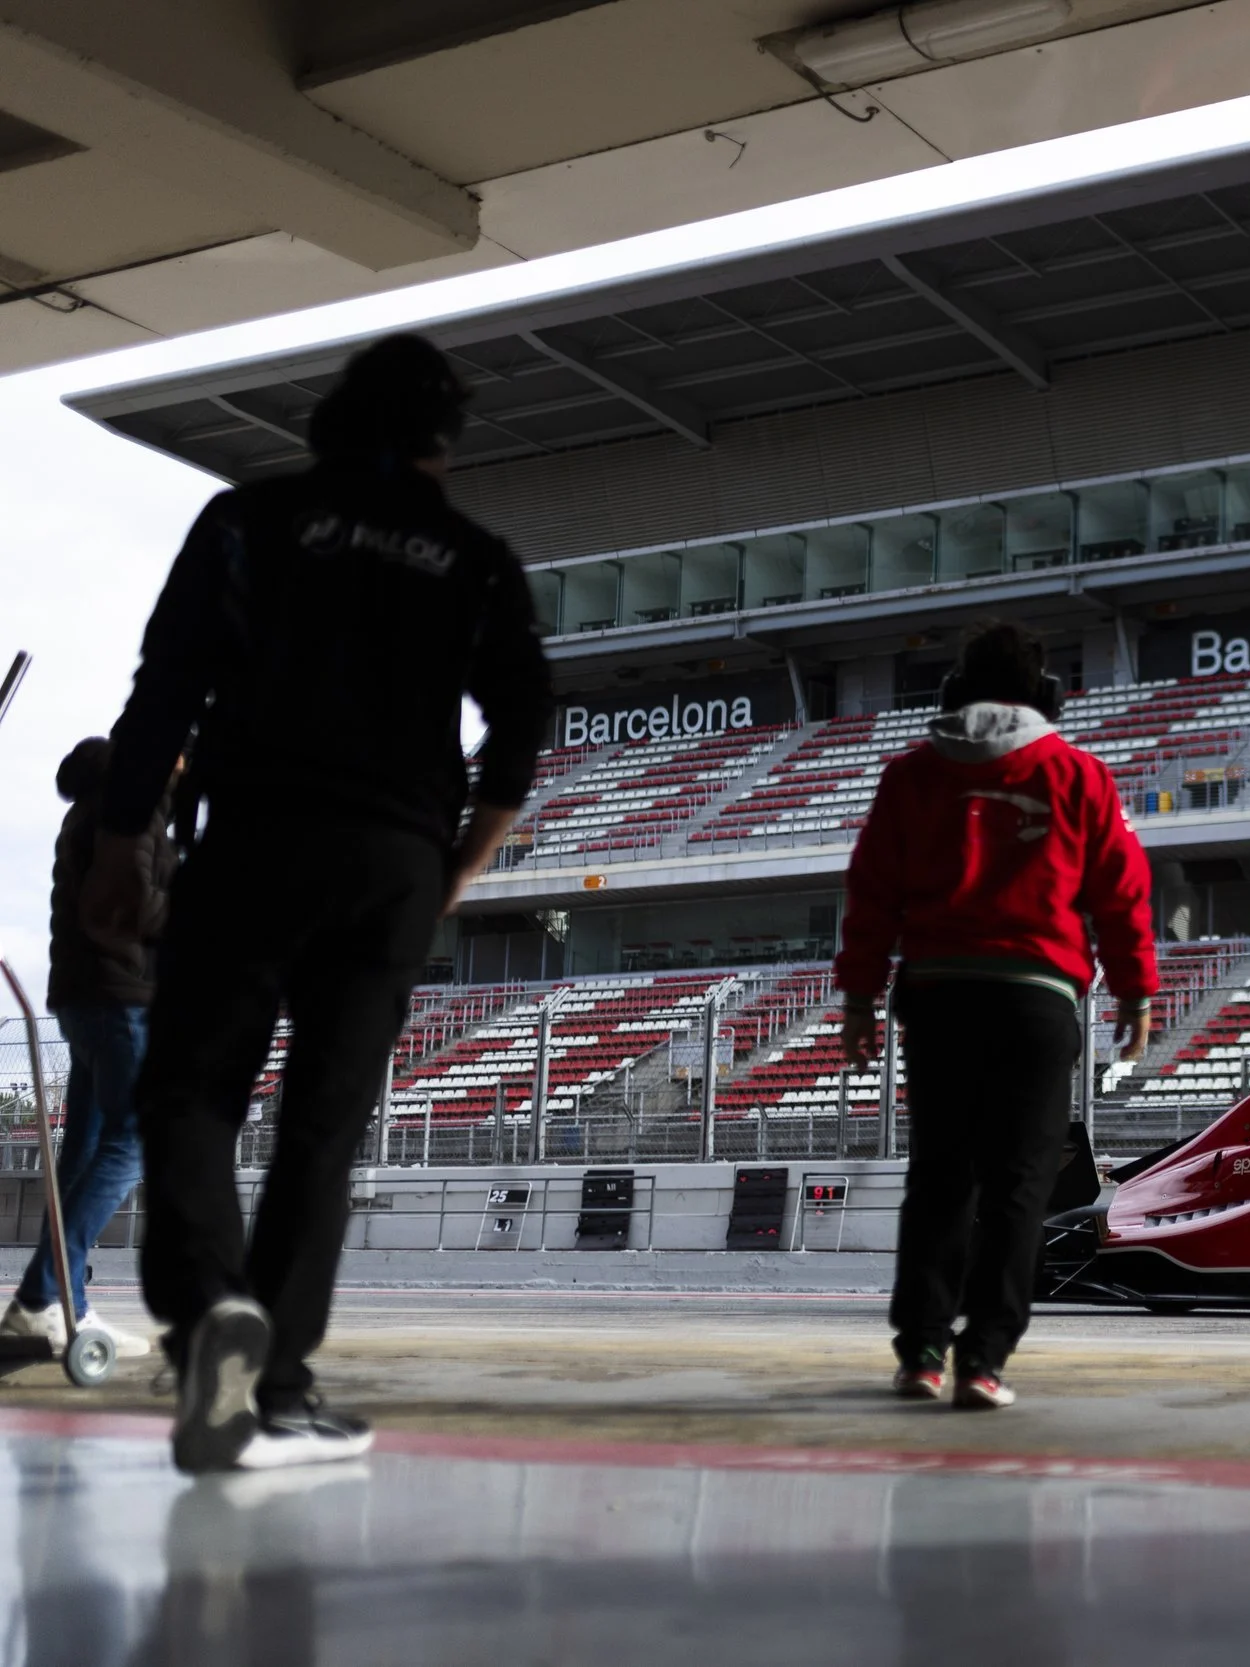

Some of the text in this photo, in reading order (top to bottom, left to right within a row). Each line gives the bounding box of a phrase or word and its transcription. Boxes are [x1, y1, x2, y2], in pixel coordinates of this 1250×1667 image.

[564, 693, 753, 747] Barcelona
[597, 875, 607, 889] 2
[489, 1190, 509, 1203] 25
[813, 1186, 835, 1200] 91
